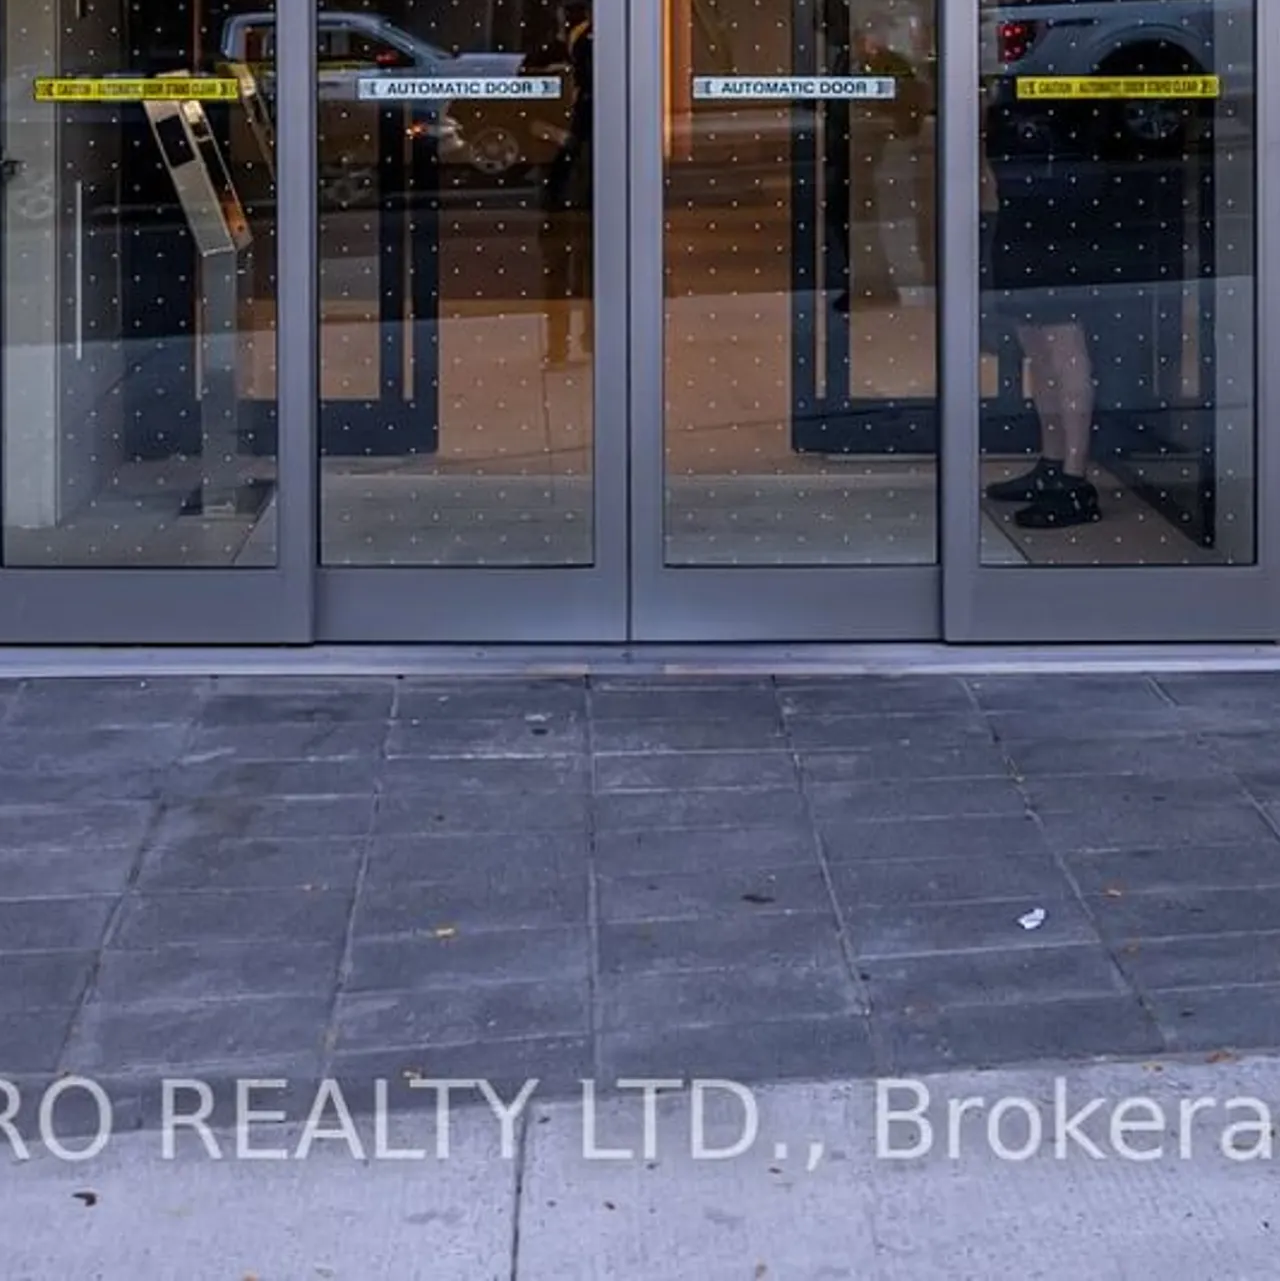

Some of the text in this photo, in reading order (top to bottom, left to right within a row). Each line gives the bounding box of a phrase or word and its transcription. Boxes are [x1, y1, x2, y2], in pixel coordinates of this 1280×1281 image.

[387, 80, 532, 95] AUTOMATIC DOOR
[721, 80, 867, 95] AUTOMATIC DOOR
